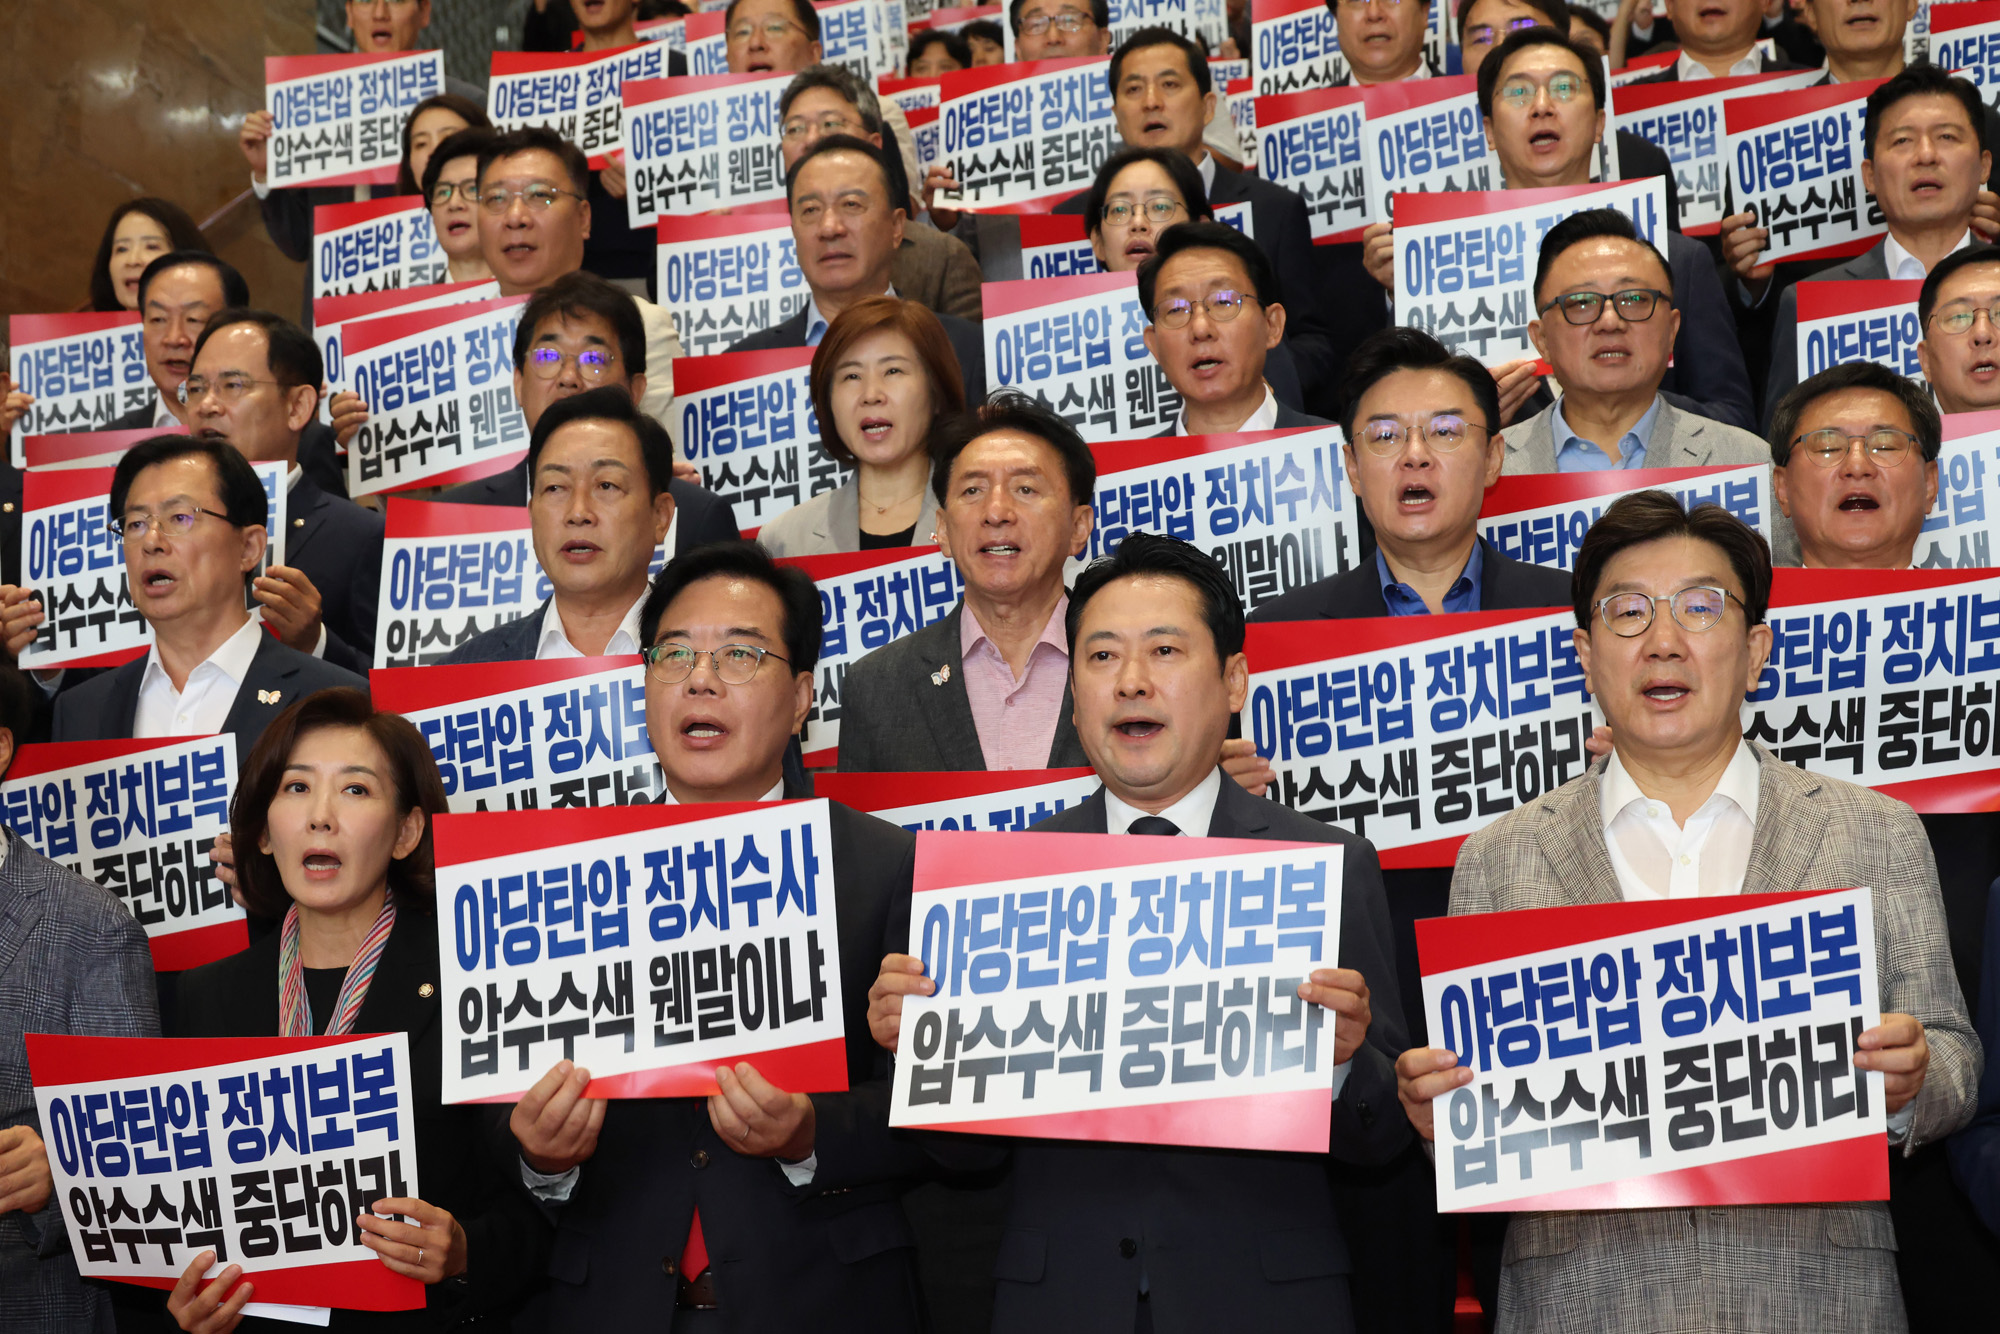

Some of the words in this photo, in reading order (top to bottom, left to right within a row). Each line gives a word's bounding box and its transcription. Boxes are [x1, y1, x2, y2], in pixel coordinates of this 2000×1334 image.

[1260, 9, 1341, 71] 야당탄압
[272, 75, 353, 129] 야당탄압
[358, 57, 439, 113] 정치보복
[494, 70, 580, 119] 야당탄압
[631, 98, 720, 161] 야당탄압
[945, 85, 1033, 154] 야당탄압
[273, 124, 353, 178] 압수수색
[359, 108, 409, 163] 중단
[1265, 110, 1361, 181] 야당탄압
[1379, 103, 1486, 181] 야당탄압
[1737, 111, 1852, 195] 야당탄압
[635, 152, 720, 215] 압수수색
[322, 219, 402, 283] 야당탄압
[667, 241, 770, 304] 야당탄압
[1405, 221, 1526, 297] 야당탄압
[19, 336, 115, 400] 야당탄압
[355, 335, 457, 415] 야당탄압
[995, 305, 1113, 386] 야당탄압
[358, 398, 462, 482] 압수수색
[683, 378, 797, 460] 야당탄압
[1204, 442, 1344, 537] 정치수사
[389, 537, 528, 612] 야당탄압
[1251, 656, 1415, 763] 야당탄압
[1425, 624, 1592, 734] 정치보복
[412, 699, 535, 797] 당탄압
[84, 745, 229, 850] 정치보복
[454, 855, 631, 972] 야당탄압
[643, 822, 819, 942] 정치수사
[920, 881, 1117, 998] 야당탄압
[1127, 860, 1327, 978] 정치보복
[459, 959, 635, 1080] 압수수색
[649, 929, 827, 1048] 웬말이냐
[1440, 946, 1642, 1073] 야당탄압
[1652, 904, 1862, 1038] 정치보복
[908, 992, 1107, 1107] 압수수색
[1119, 976, 1324, 1089] 중단하라
[49, 1080, 210, 1178] 야당탄압
[218, 1046, 400, 1164] 정치보복
[1449, 1054, 1652, 1190] 압수수색
[1663, 1015, 1870, 1153] 중단하라
[68, 1176, 228, 1266] 압수수색
[230, 1149, 408, 1259] 중단하라
